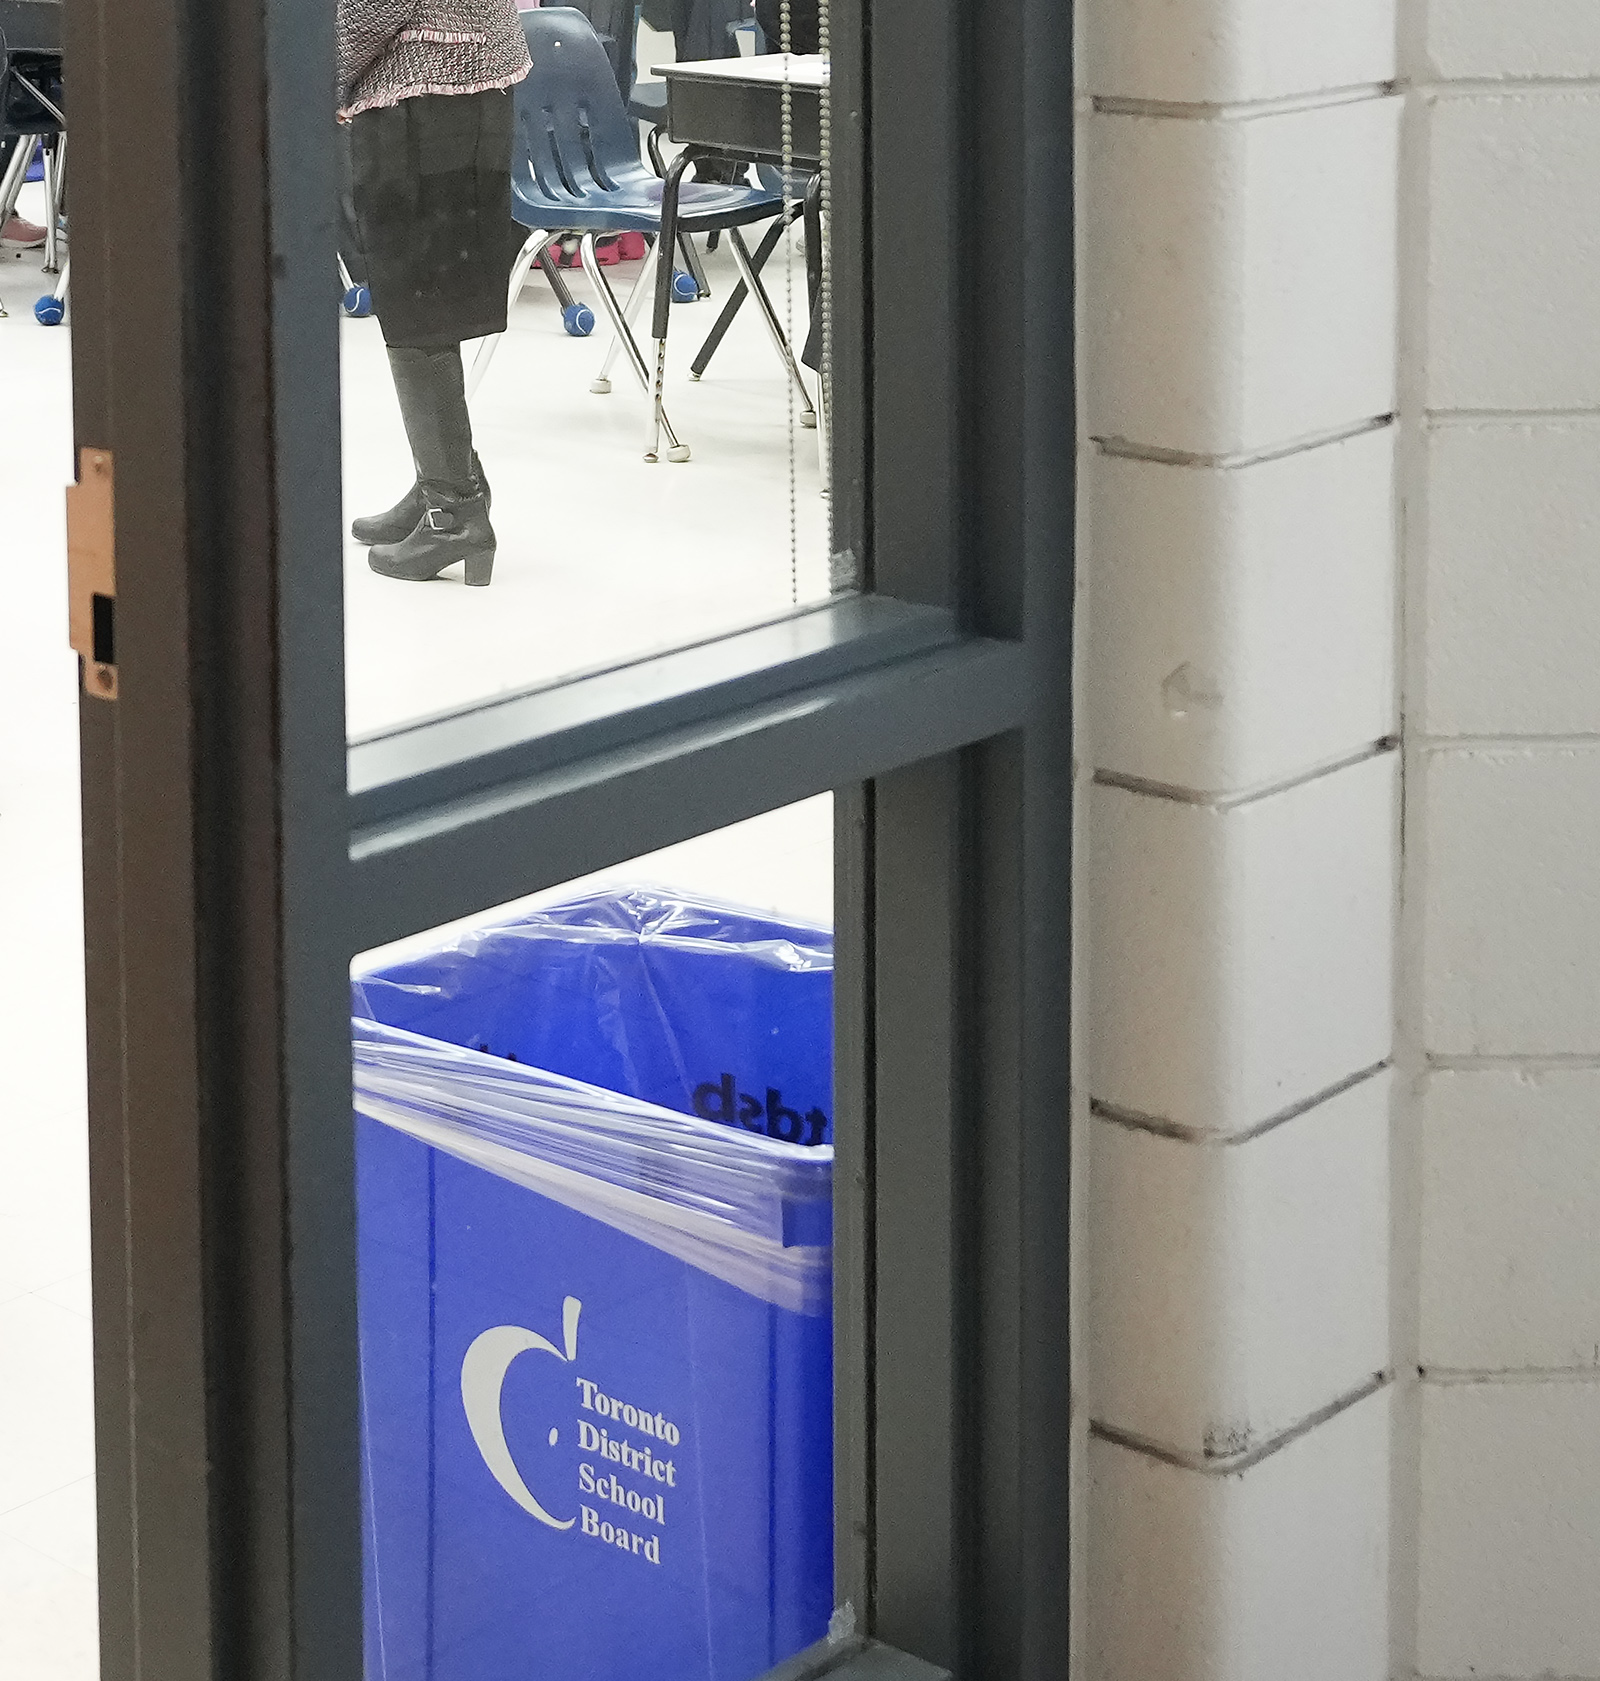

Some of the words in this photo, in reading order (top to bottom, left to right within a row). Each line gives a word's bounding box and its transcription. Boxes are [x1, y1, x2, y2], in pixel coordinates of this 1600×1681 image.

[576, 1376, 680, 1447] Toronto
[577, 1419, 677, 1488] District
[578, 1462, 666, 1526] School
[580, 1503, 661, 1565] Board
